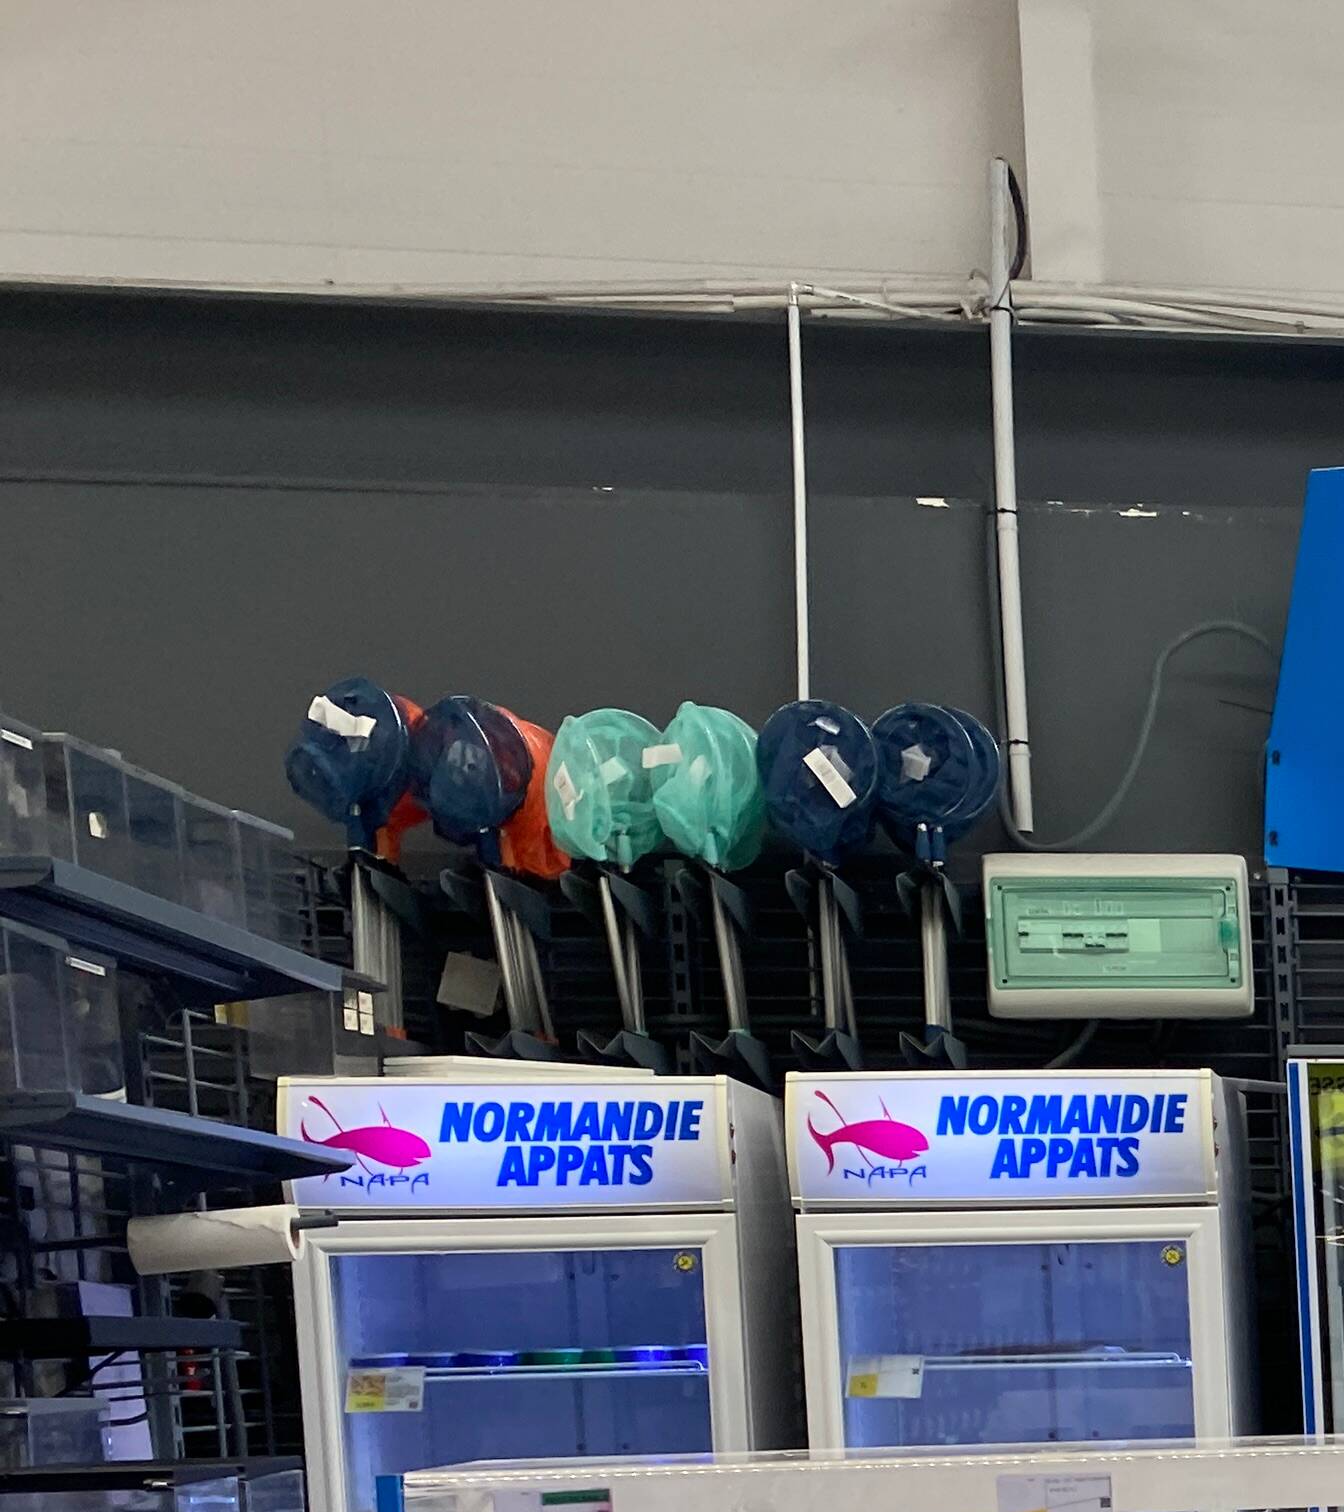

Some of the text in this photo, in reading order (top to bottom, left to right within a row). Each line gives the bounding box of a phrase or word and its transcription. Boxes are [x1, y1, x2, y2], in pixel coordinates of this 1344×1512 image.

[438, 1100, 705, 1142] NORMANDIE
[935, 1092, 1189, 1136] NORMANDIE
[496, 1144, 654, 1188] APPATS
[842, 1164, 928, 1188] NAPA
[988, 1136, 1140, 1180] APPATS
[340, 1170, 430, 1195] NAPA
